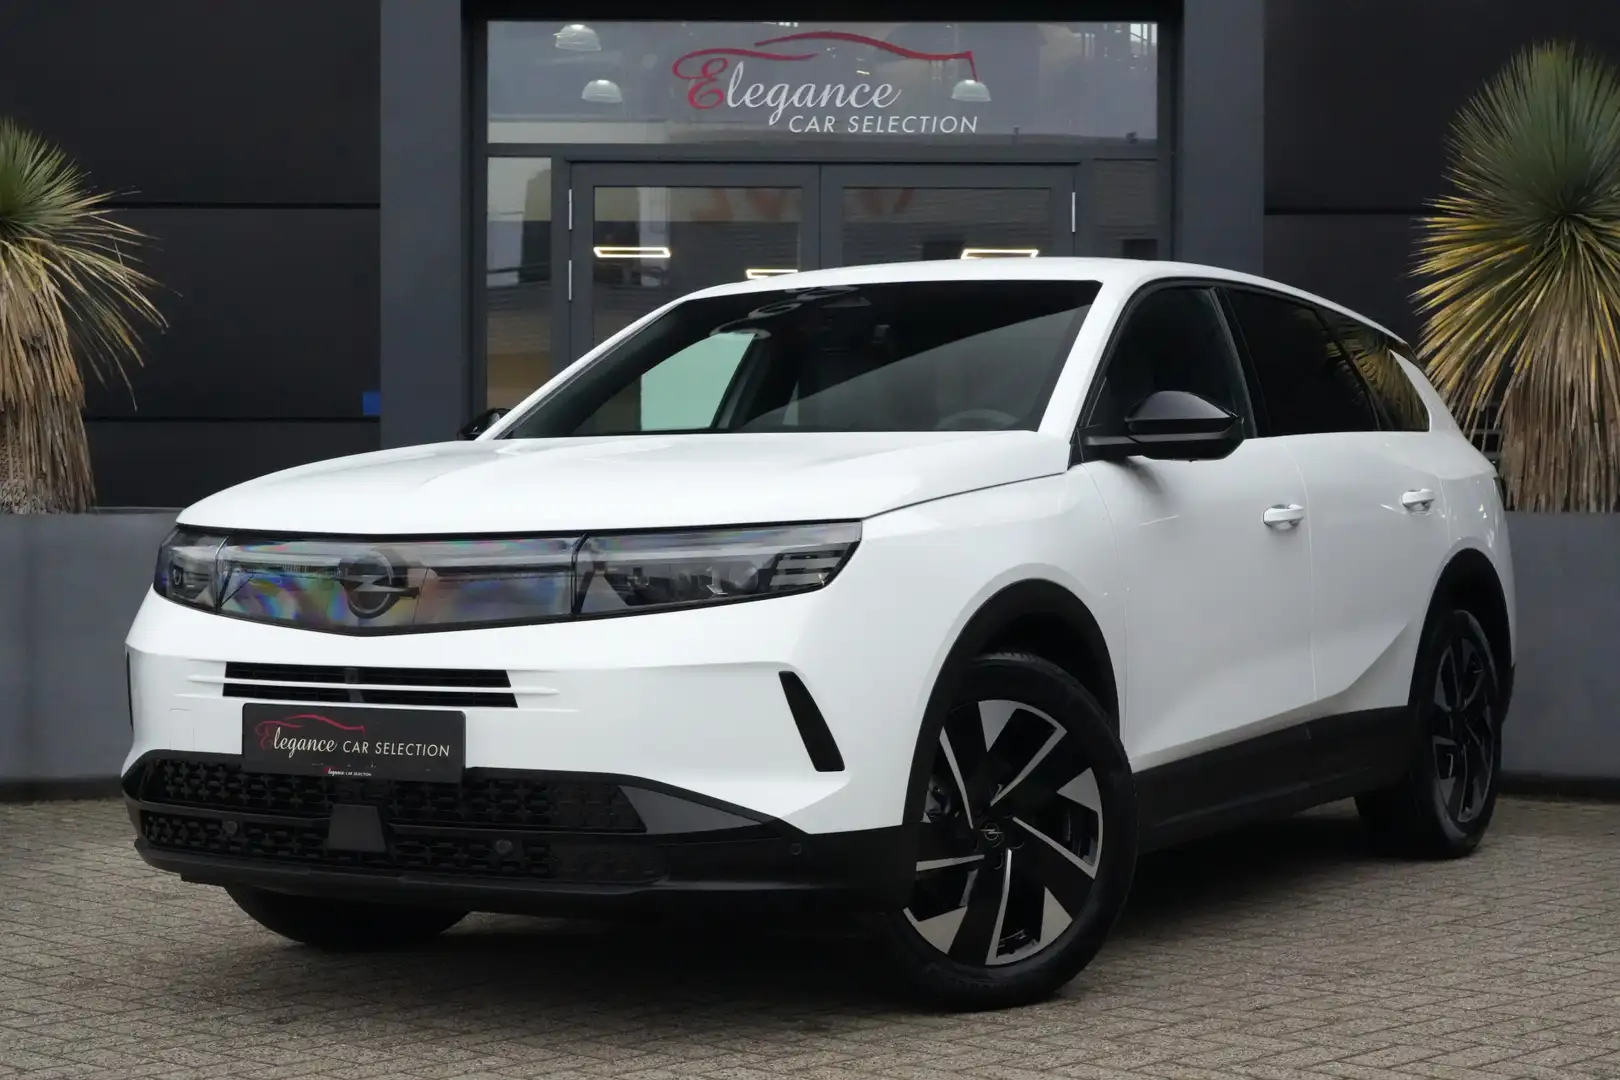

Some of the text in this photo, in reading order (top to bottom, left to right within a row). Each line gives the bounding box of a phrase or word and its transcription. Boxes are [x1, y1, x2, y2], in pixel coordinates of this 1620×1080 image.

[673, 50, 902, 126] Elegance
[788, 114, 978, 133] CAR SELECTION
[256, 722, 450, 758] Elegance CAR SELECTION
